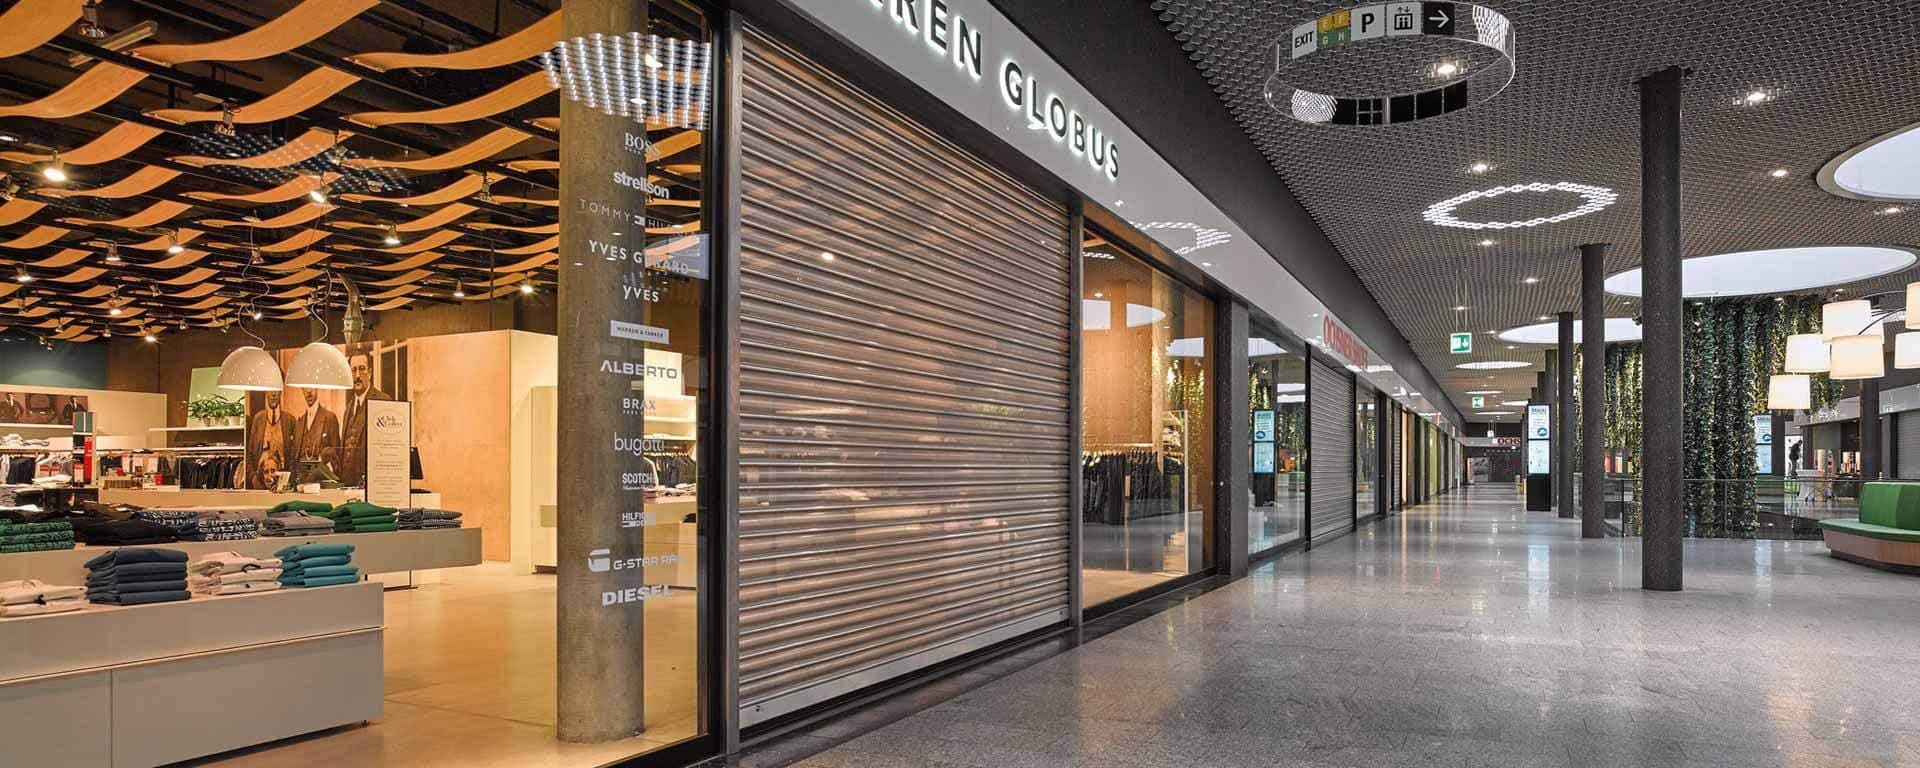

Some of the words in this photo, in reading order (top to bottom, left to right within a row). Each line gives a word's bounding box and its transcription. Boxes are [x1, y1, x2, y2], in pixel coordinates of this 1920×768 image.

[1361, 12, 1375, 33] P
[1294, 31, 1314, 48] EXIT
[1322, 36, 1329, 45] G
[1003, 60, 1119, 178] GLOBUS
[613, 171, 670, 199] strellson
[580, 199, 631, 222] TOMMY
[588, 240, 627, 260] YVES
[633, 252, 690, 274] GRARD
[623, 285, 659, 303] YVES
[600, 360, 678, 379] ALBERTO
[623, 398, 656, 410] BRAX
[614, 432, 665, 456] bugatti
[622, 472, 653, 484] SCOTCH
[602, 584, 673, 606] DIESEL
